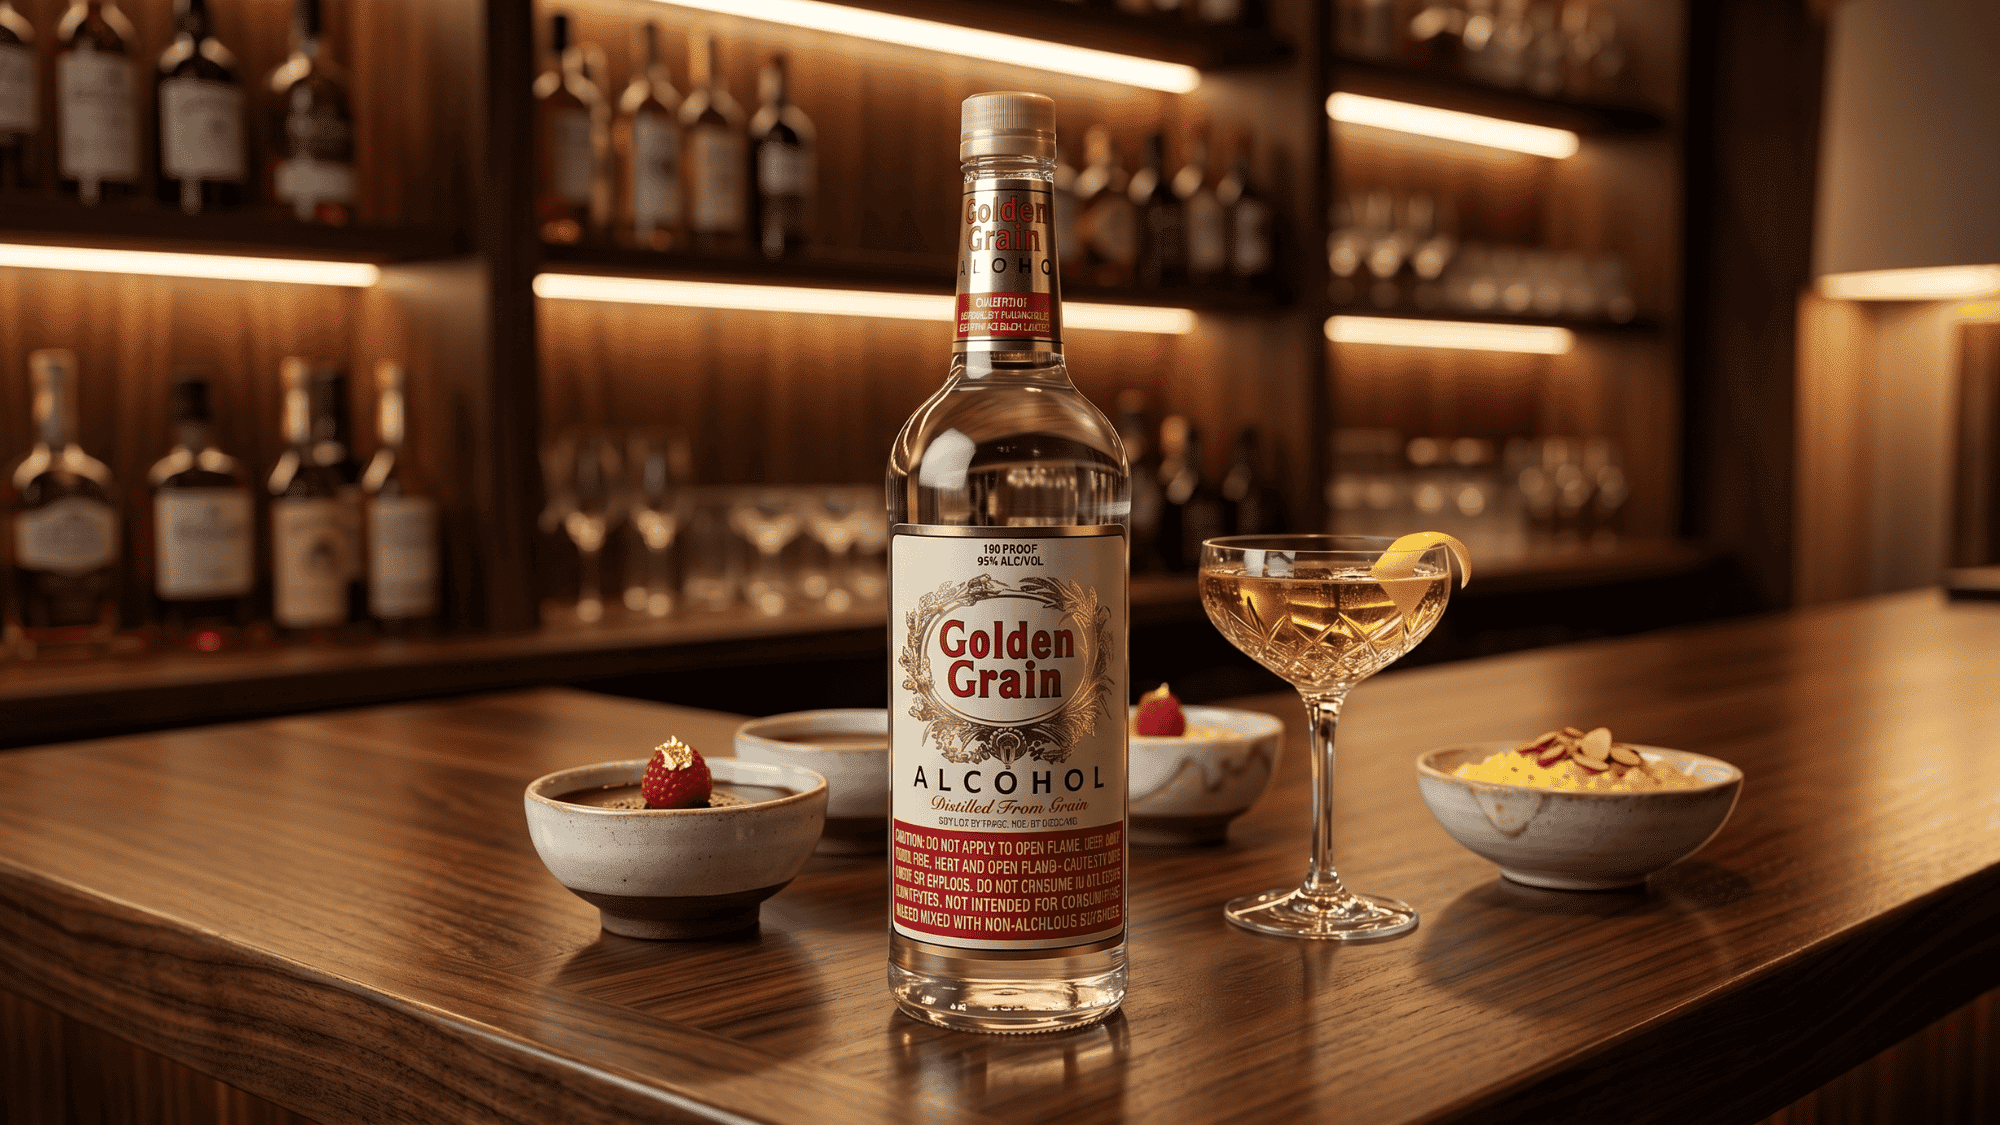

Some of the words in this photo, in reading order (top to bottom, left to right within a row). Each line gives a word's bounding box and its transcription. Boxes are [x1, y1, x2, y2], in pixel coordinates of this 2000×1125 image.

[966, 196, 1047, 224] Golden
[968, 223, 1041, 251] Grain
[983, 544, 1001, 554] 190
[1002, 544, 1038, 554] PROOF
[977, 557, 998, 566] 95%
[1001, 557, 1044, 566] ALC/VOL
[939, 619, 1075, 660] Golden
[947, 660, 1062, 699] Grain
[914, 766, 1105, 795] ALCOHOL
[931, 795, 994, 814] Distilled
[996, 799, 1046, 814] From
[1049, 797, 1089, 813] Grain
[926, 836, 939, 851] DO
[941, 838, 961, 853] NOT
[962, 840, 996, 855] APPLY
[998, 841, 1012, 855] TO
[1016, 841, 1044, 855] OPEN
[935, 856, 960, 872] HERT
[962, 859, 984, 874] AND
[988, 860, 1018, 874] OPEN
[976, 879, 992, 893] DO
[995, 880, 1018, 894] NOT
[945, 894, 969, 911] NOT
[971, 897, 1030, 912] INTENDED
[1034, 896, 1058, 912] FOR
[920, 909, 950, 928] MIXED
[953, 914, 981, 931] WITH
